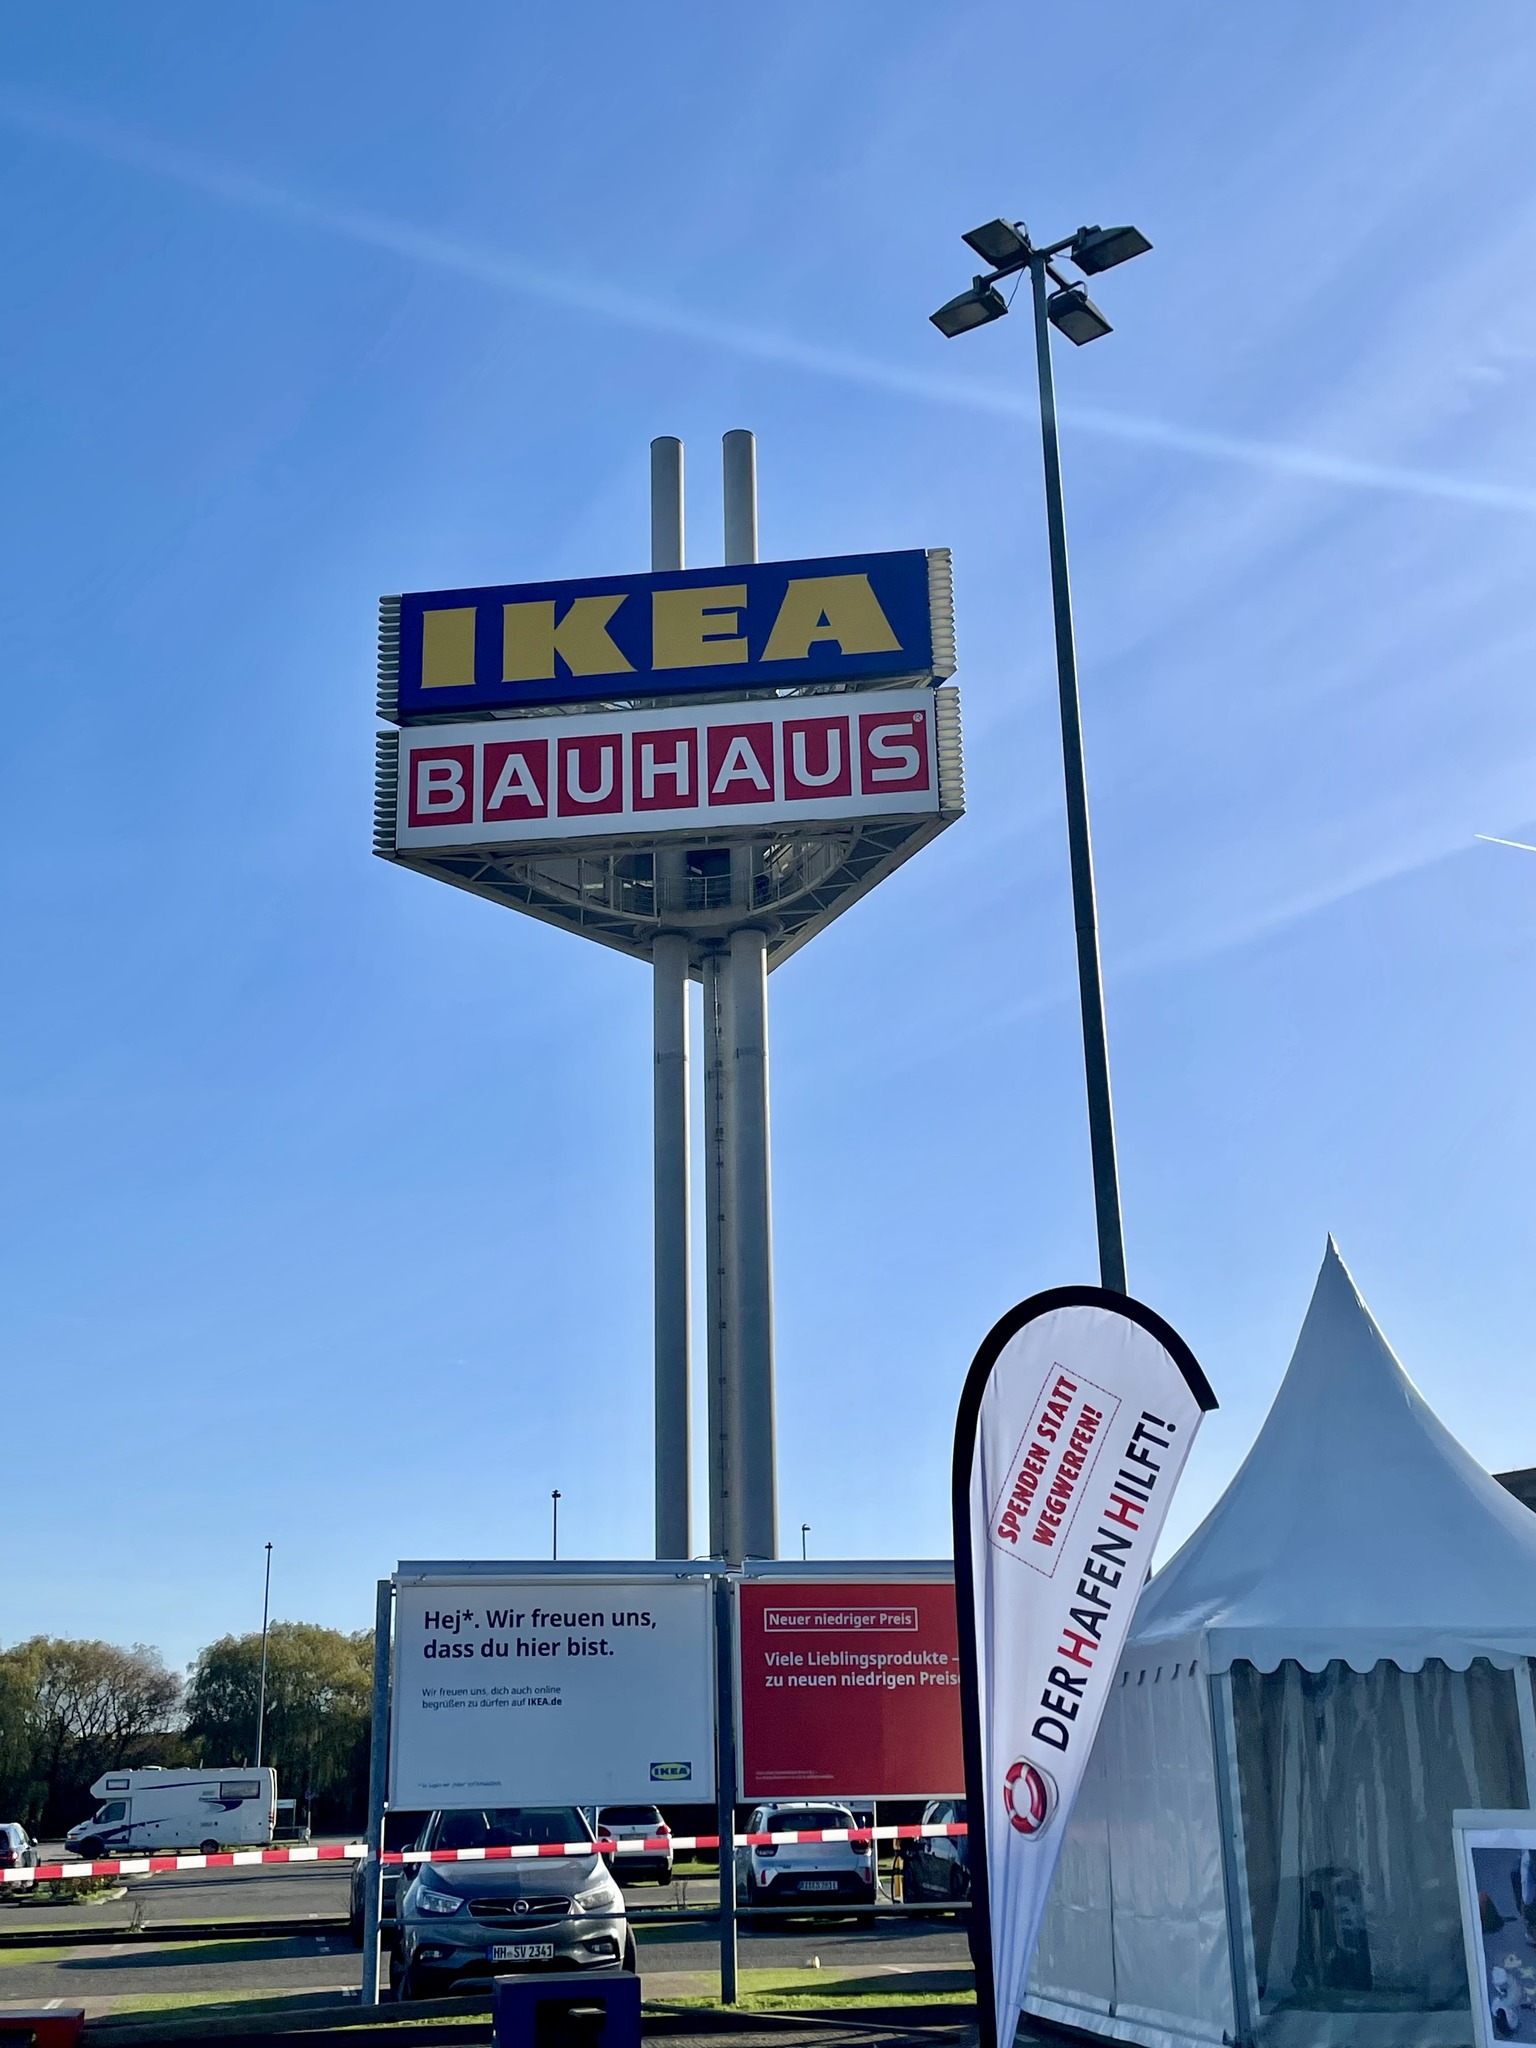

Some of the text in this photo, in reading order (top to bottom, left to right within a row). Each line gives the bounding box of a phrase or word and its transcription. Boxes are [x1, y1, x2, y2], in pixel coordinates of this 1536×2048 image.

[420, 573, 904, 689] IKEA
[997, 1375, 1078, 1545] SPENDEN STATT
[1032, 1403, 1103, 1547] WEGWERFEN!
[1031, 1410, 1177, 1752] DER HAFEN HILFT!
[486, 1608, 525, 1628] Wir
[531, 1608, 604, 1627] freuen
[612, 1611, 656, 1630] uns,
[769, 1612, 912, 1629] Neuer niedriger Preis
[423, 1636, 614, 1659] dass du hier bist.
[764, 1651, 804, 1666] Viele
[807, 1650, 948, 1670] Lieblingsprodukte
[765, 1670, 960, 1690] zu neuen niedrigen Preis
[421, 1687, 437, 1697] Wir
[439, 1687, 468, 1697] freuen
[490, 1686, 510, 1696] dich
[511, 1686, 532, 1696] auch
[534, 1685, 562, 1695] online
[422, 1696, 562, 1711] begrüßen zu dürfen auf IKEA.de
[654, 1767, 688, 1776] IKEA
[493, 1946, 507, 1959] HH
[513, 1945, 527, 1958] SV
